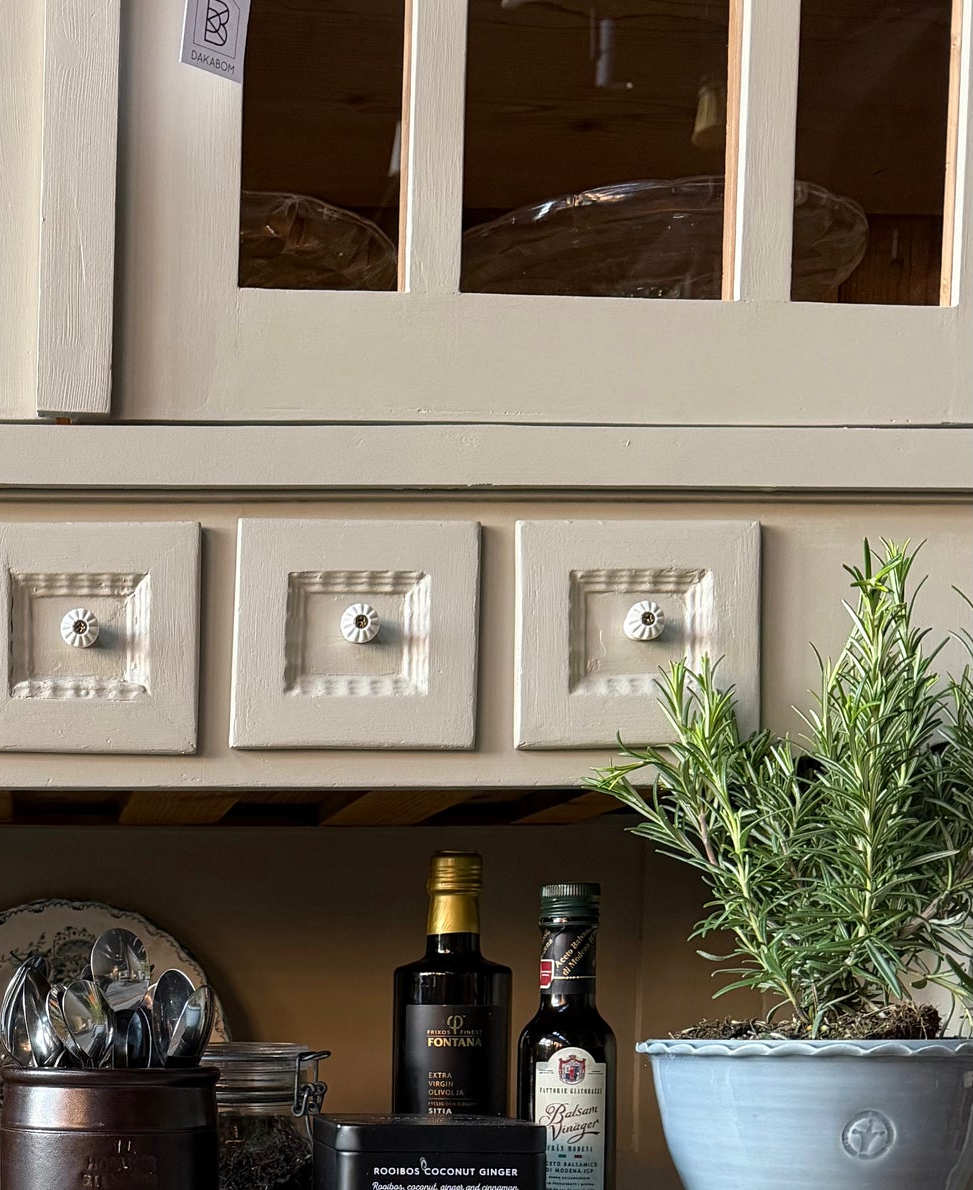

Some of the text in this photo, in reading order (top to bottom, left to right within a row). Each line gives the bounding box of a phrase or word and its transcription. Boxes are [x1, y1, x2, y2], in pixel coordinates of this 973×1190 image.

[191, 49, 235, 75] DAKABOM
[427, 1037, 483, 1047] FONTANA
[428, 1071, 453, 1079] EXTRA
[428, 1080, 454, 1088] VIRGIN
[428, 1107, 453, 1115] SITIA
[539, 1102, 598, 1126] Balsam
[551, 1118, 601, 1145] Vinäger
[373, 1167, 518, 1176] ROOIBOS COCONUT GINGER
